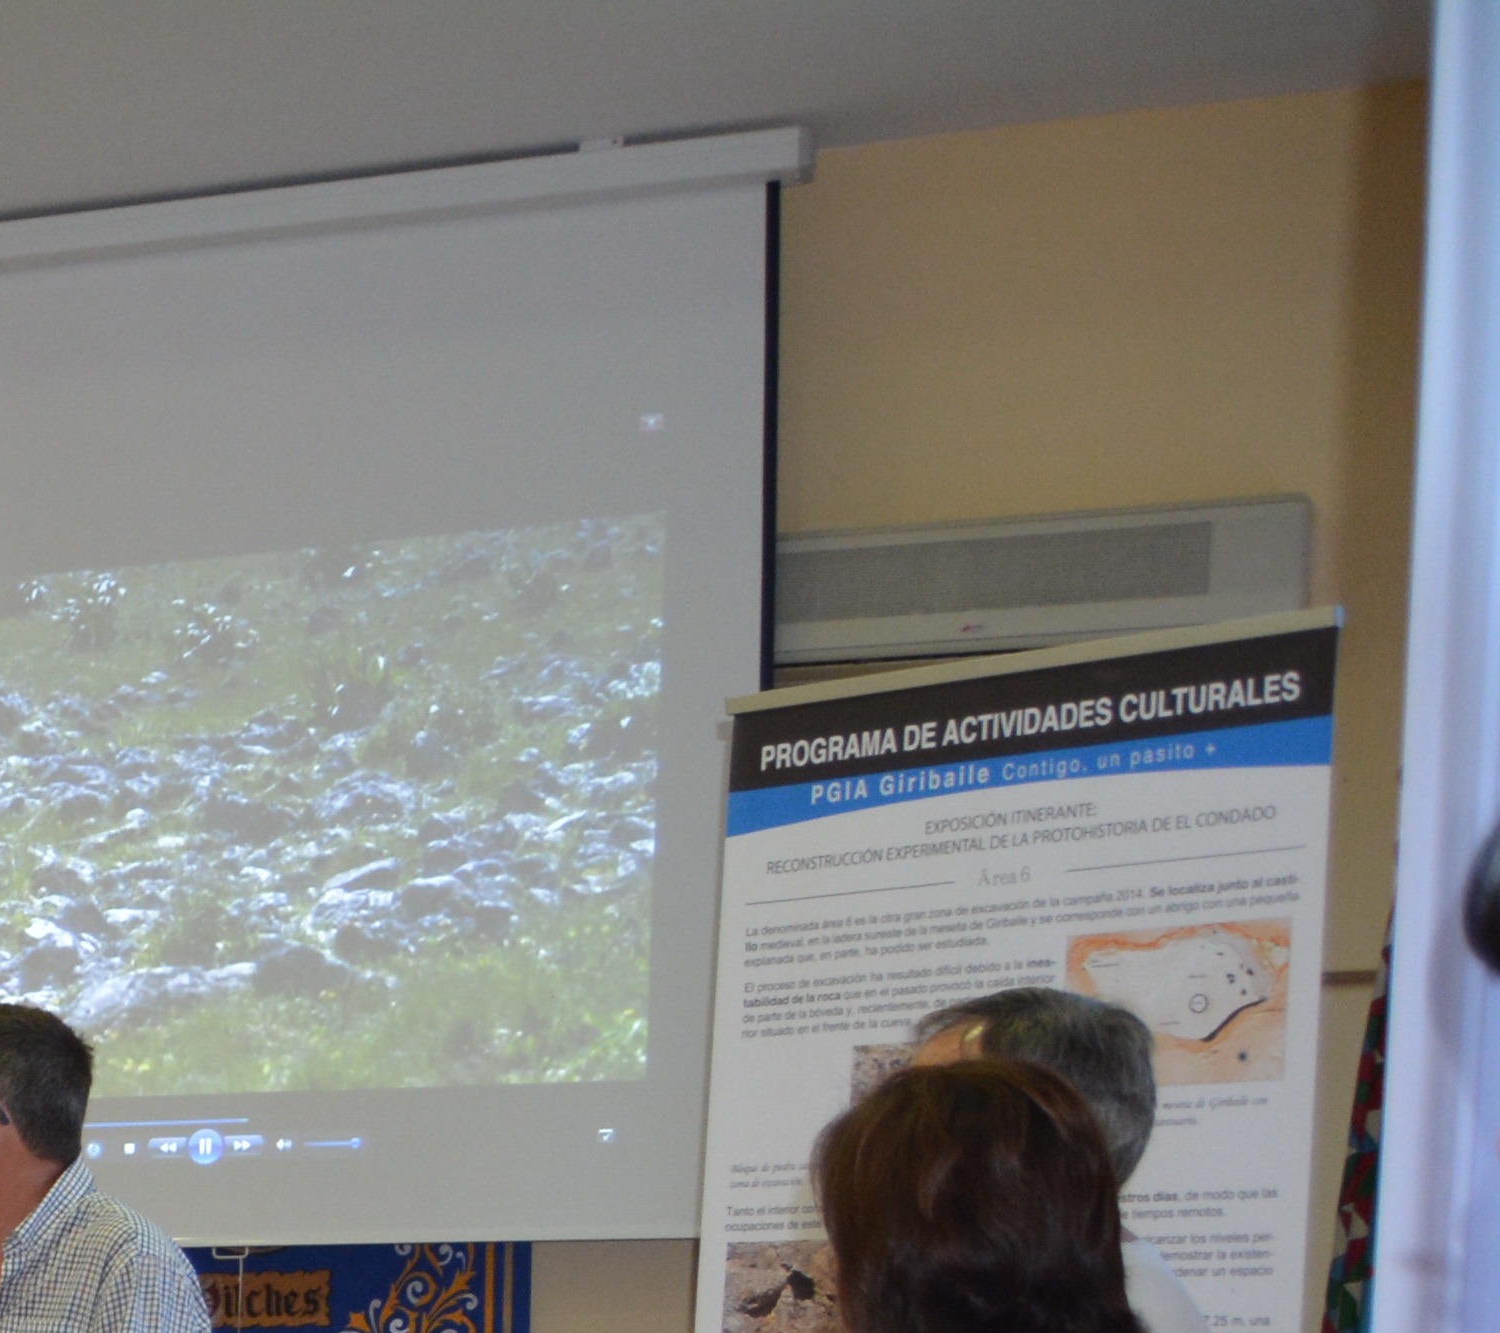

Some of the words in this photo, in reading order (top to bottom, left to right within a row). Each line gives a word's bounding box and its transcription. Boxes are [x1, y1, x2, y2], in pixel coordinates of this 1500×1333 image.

[760, 729, 897, 769] PROGRAMA
[903, 721, 937, 751] DE
[942, 698, 1113, 744] ACTIVIDADES
[1119, 672, 1300, 721] CULTURALES
[811, 780, 868, 805] PGIA
[879, 767, 990, 797] Giribaile
[1002, 760, 1088, 782] Contigo,
[1098, 756, 1120, 771] un
[1130, 745, 1196, 770] pasito
[766, 849, 883, 874] RECONSTRUCCIÓN
[886, 838, 986, 860] EXPERIMENTAL
[989, 834, 1008, 850] DE
[1012, 832, 1029, 847] LA
[1032, 820, 1148, 843] PROTOHISTORIA
[1151, 816, 1171, 832] DE
[1175, 815, 1191, 830] EL
[1195, 805, 1276, 827] CONDADO
[925, 812, 1007, 835] EXPOSICIÓN
[1011, 802, 1096, 823] ITINERANTE:
[1020, 865, 1030, 883] 6
